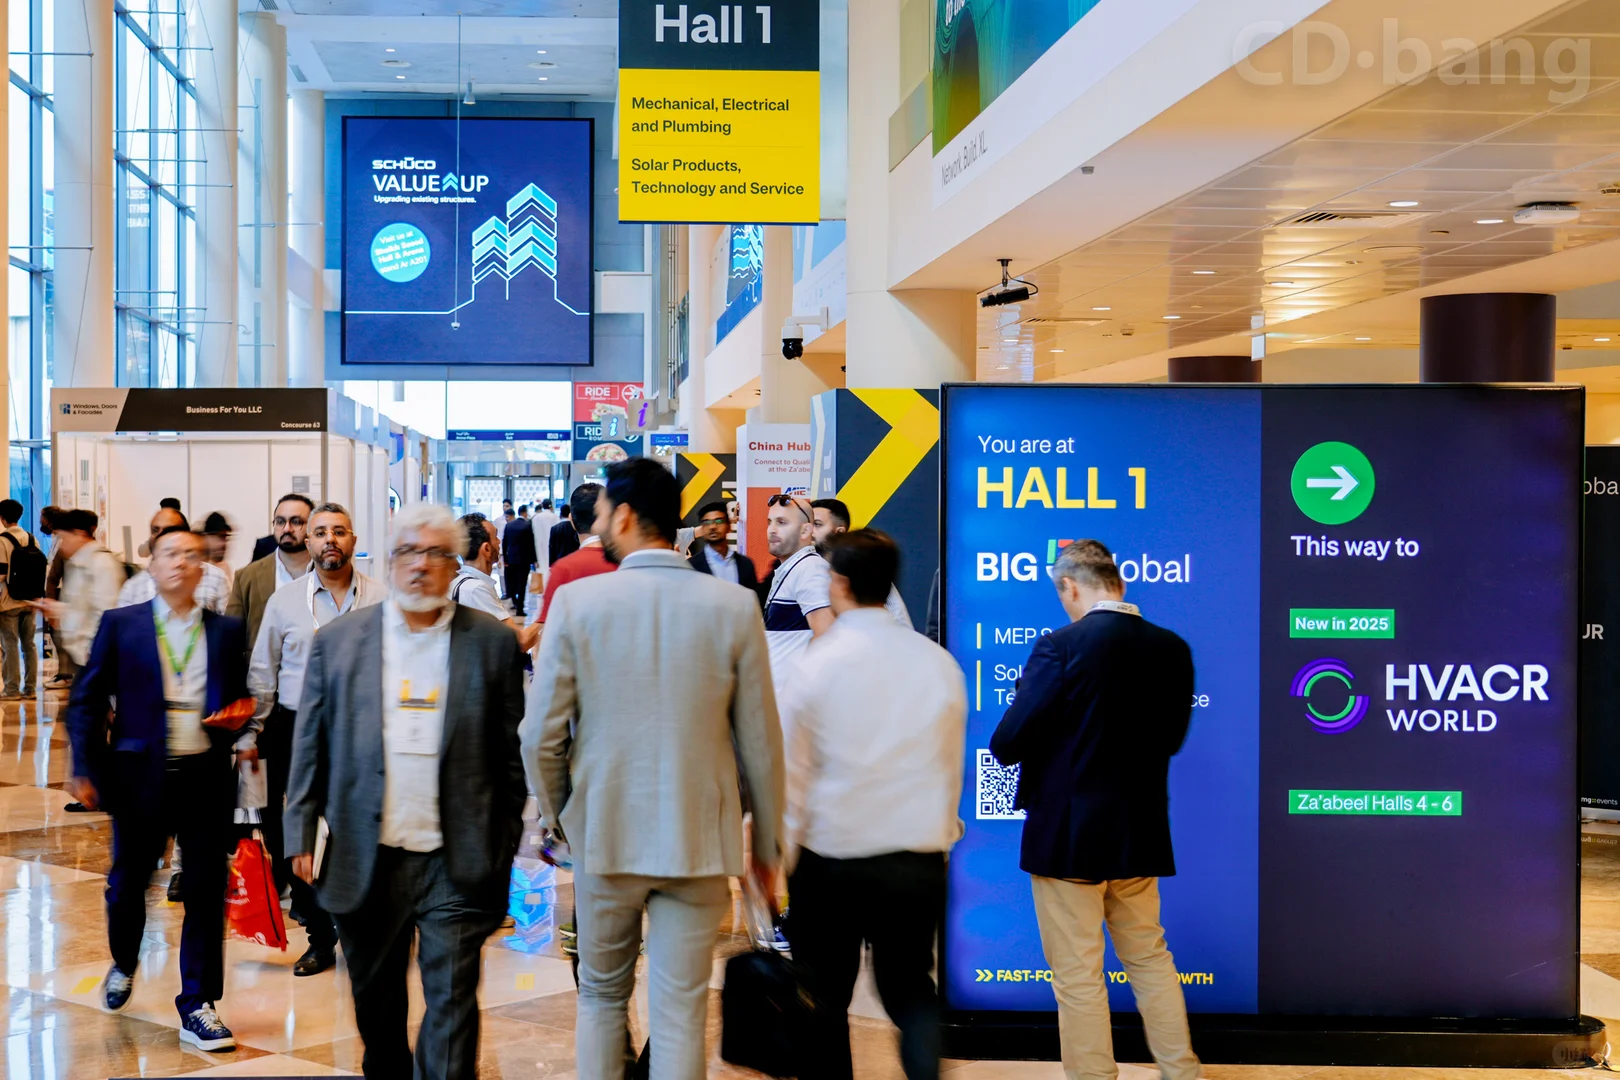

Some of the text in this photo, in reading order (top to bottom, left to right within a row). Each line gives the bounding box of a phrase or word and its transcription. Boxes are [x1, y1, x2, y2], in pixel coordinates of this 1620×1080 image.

[655, 4, 771, 44] Hall 1
[632, 97, 789, 112] Mechanical, Electrical
[632, 120, 732, 136] and Plumbing
[372, 157, 436, 170] SCHÜCO
[632, 159, 741, 173] Solar Products,
[372, 174, 489, 192] VALUE UP
[632, 181, 804, 196] Technology and Service
[373, 195, 411, 204] Upgrading
[412, 195, 439, 204] existing
[379, 230, 414, 244] Visit us at
[585, 387, 610, 396] RIDE
[749, 442, 811, 451] China Hub
[978, 435, 1074, 453] You are at
[977, 467, 1146, 509] HALL 1
[1290, 535, 1419, 561] This way to
[976, 552, 1037, 581] BIG
[1295, 617, 1389, 631] New in 2025
[994, 627, 1037, 644] MEP
[994, 664, 1022, 681] Sol
[1385, 663, 1549, 702] HVACR
[1386, 709, 1498, 732] WORLD
[1372, 795, 1412, 811] Halls
[1416, 795, 1427, 811] 4
[1442, 795, 1453, 811] 6
[996, 969, 1054, 982] FAST-FO
[1107, 971, 1131, 983] YO
